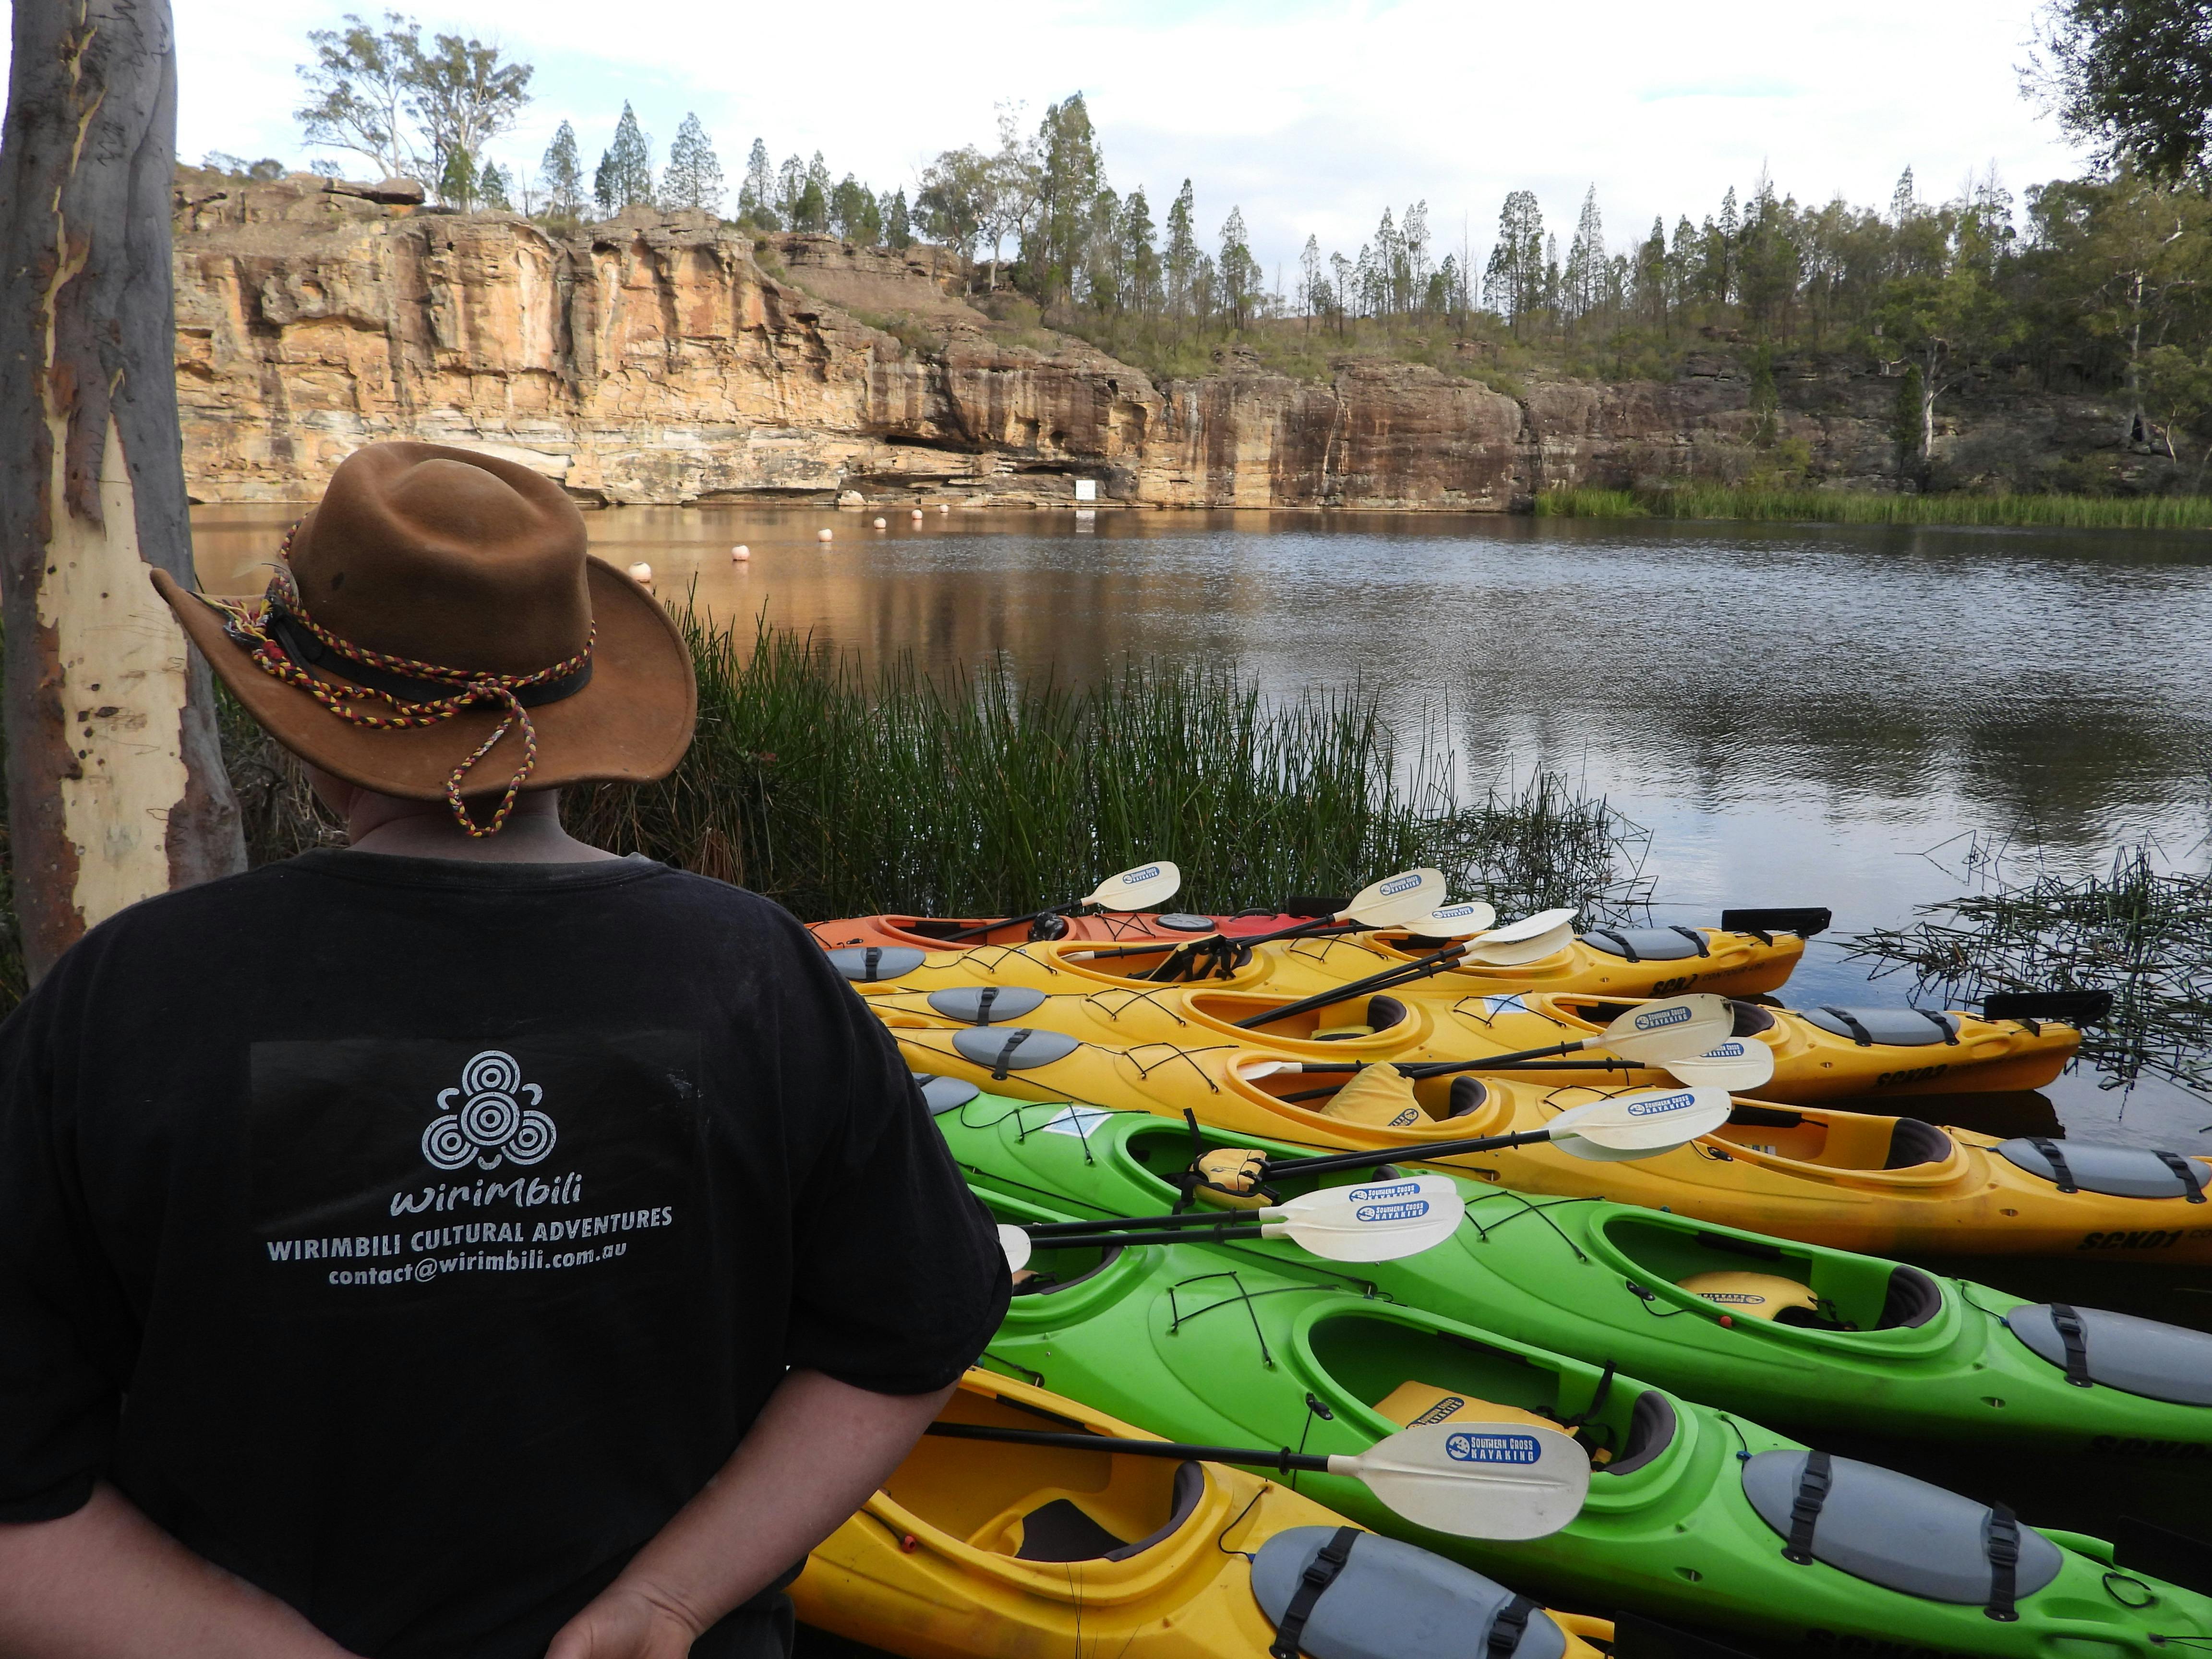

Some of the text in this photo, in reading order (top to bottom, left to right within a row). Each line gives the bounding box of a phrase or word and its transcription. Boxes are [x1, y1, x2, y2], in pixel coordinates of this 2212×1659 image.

[1650, 1013, 1688, 1026] KAYAKING
[1644, 1095, 1689, 1108] SOUTHERN CROSS
[1646, 1100, 1691, 1113] KAYAKING
[1368, 1185, 1415, 1196] SOUTHERN CROSS
[1375, 1209, 1423, 1220] KAYAKING
[1376, 1202, 1424, 1214] SOUTHERN CROSS
[267, 1205, 673, 1262] WIRIMBILI CULTURAL ADVENTURES
[328, 1242, 627, 1285] contact@wirimbili.com.au
[1471, 1436, 1533, 1450] SOUTHERN CROSS
[1471, 1448, 1534, 1461] KAYAKING
